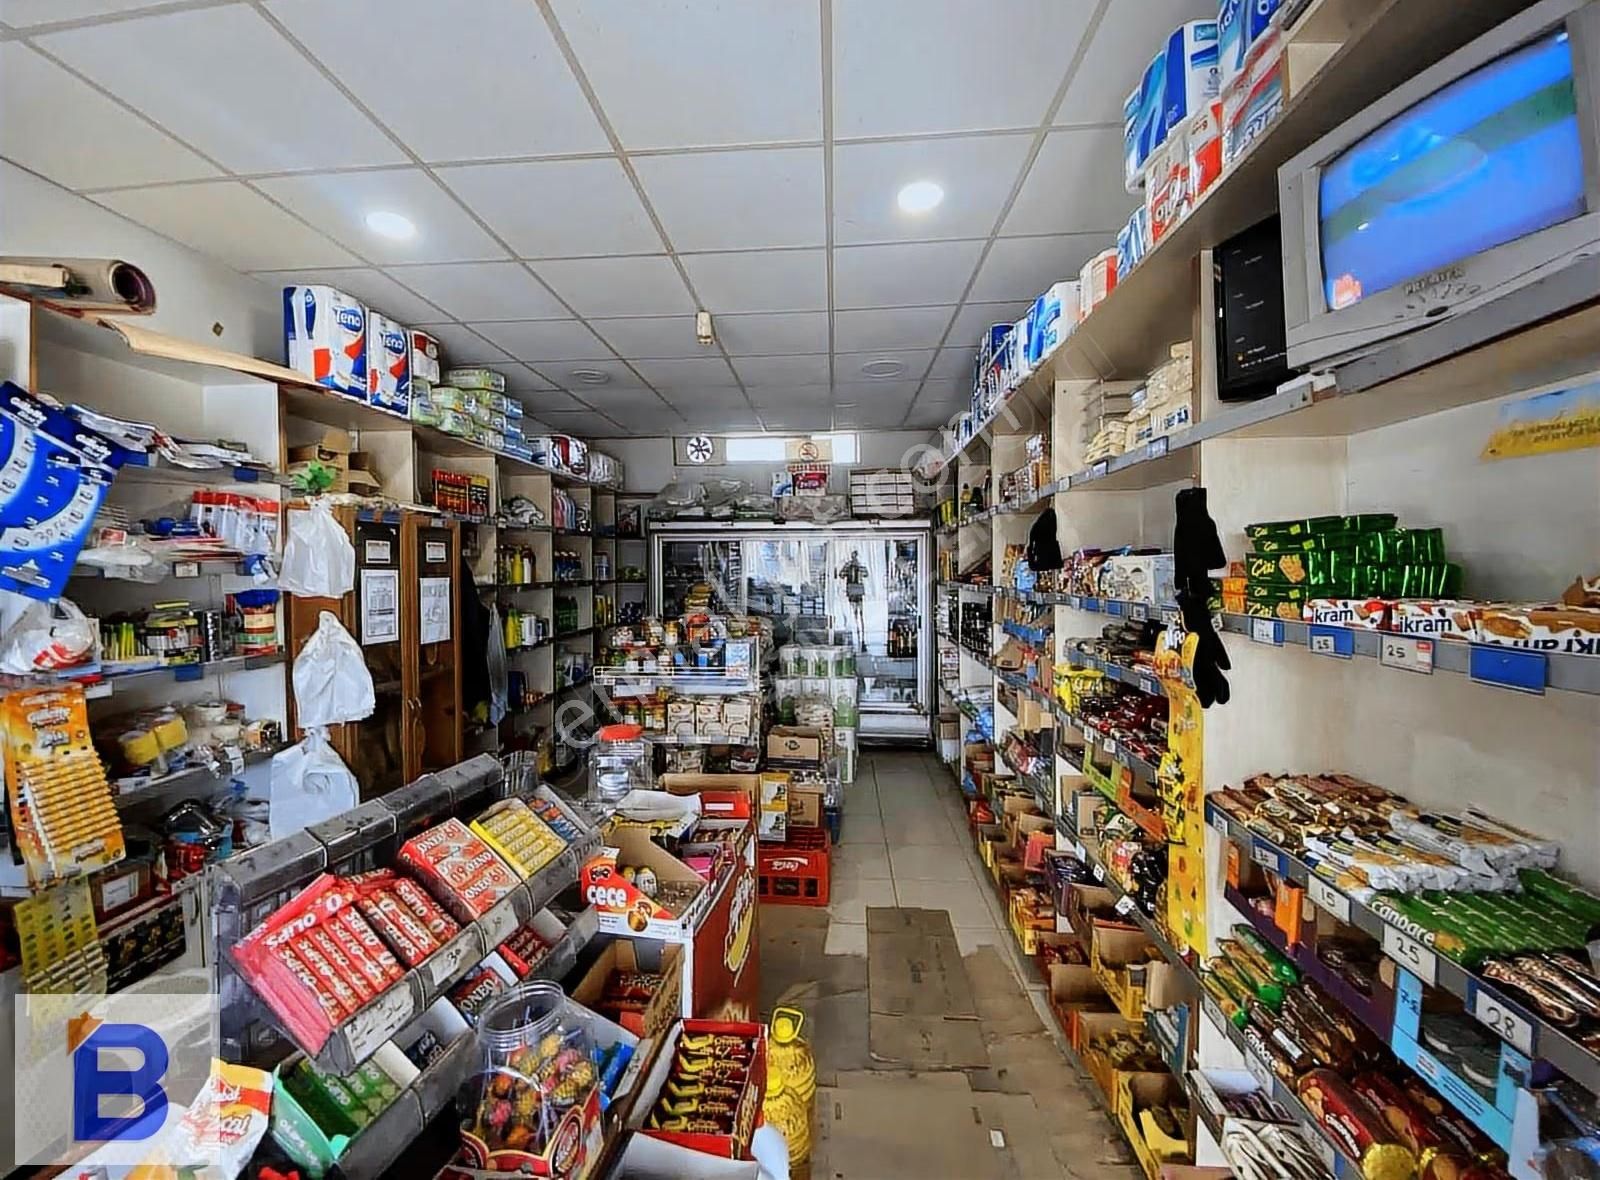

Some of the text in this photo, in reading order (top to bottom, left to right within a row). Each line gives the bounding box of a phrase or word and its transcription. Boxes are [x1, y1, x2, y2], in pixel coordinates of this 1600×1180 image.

[1400, 615, 1452, 634] ikram
[586, 885, 627, 908] cece
[1396, 936, 1420, 965] 25
[1487, 1006, 1516, 1040] 28
